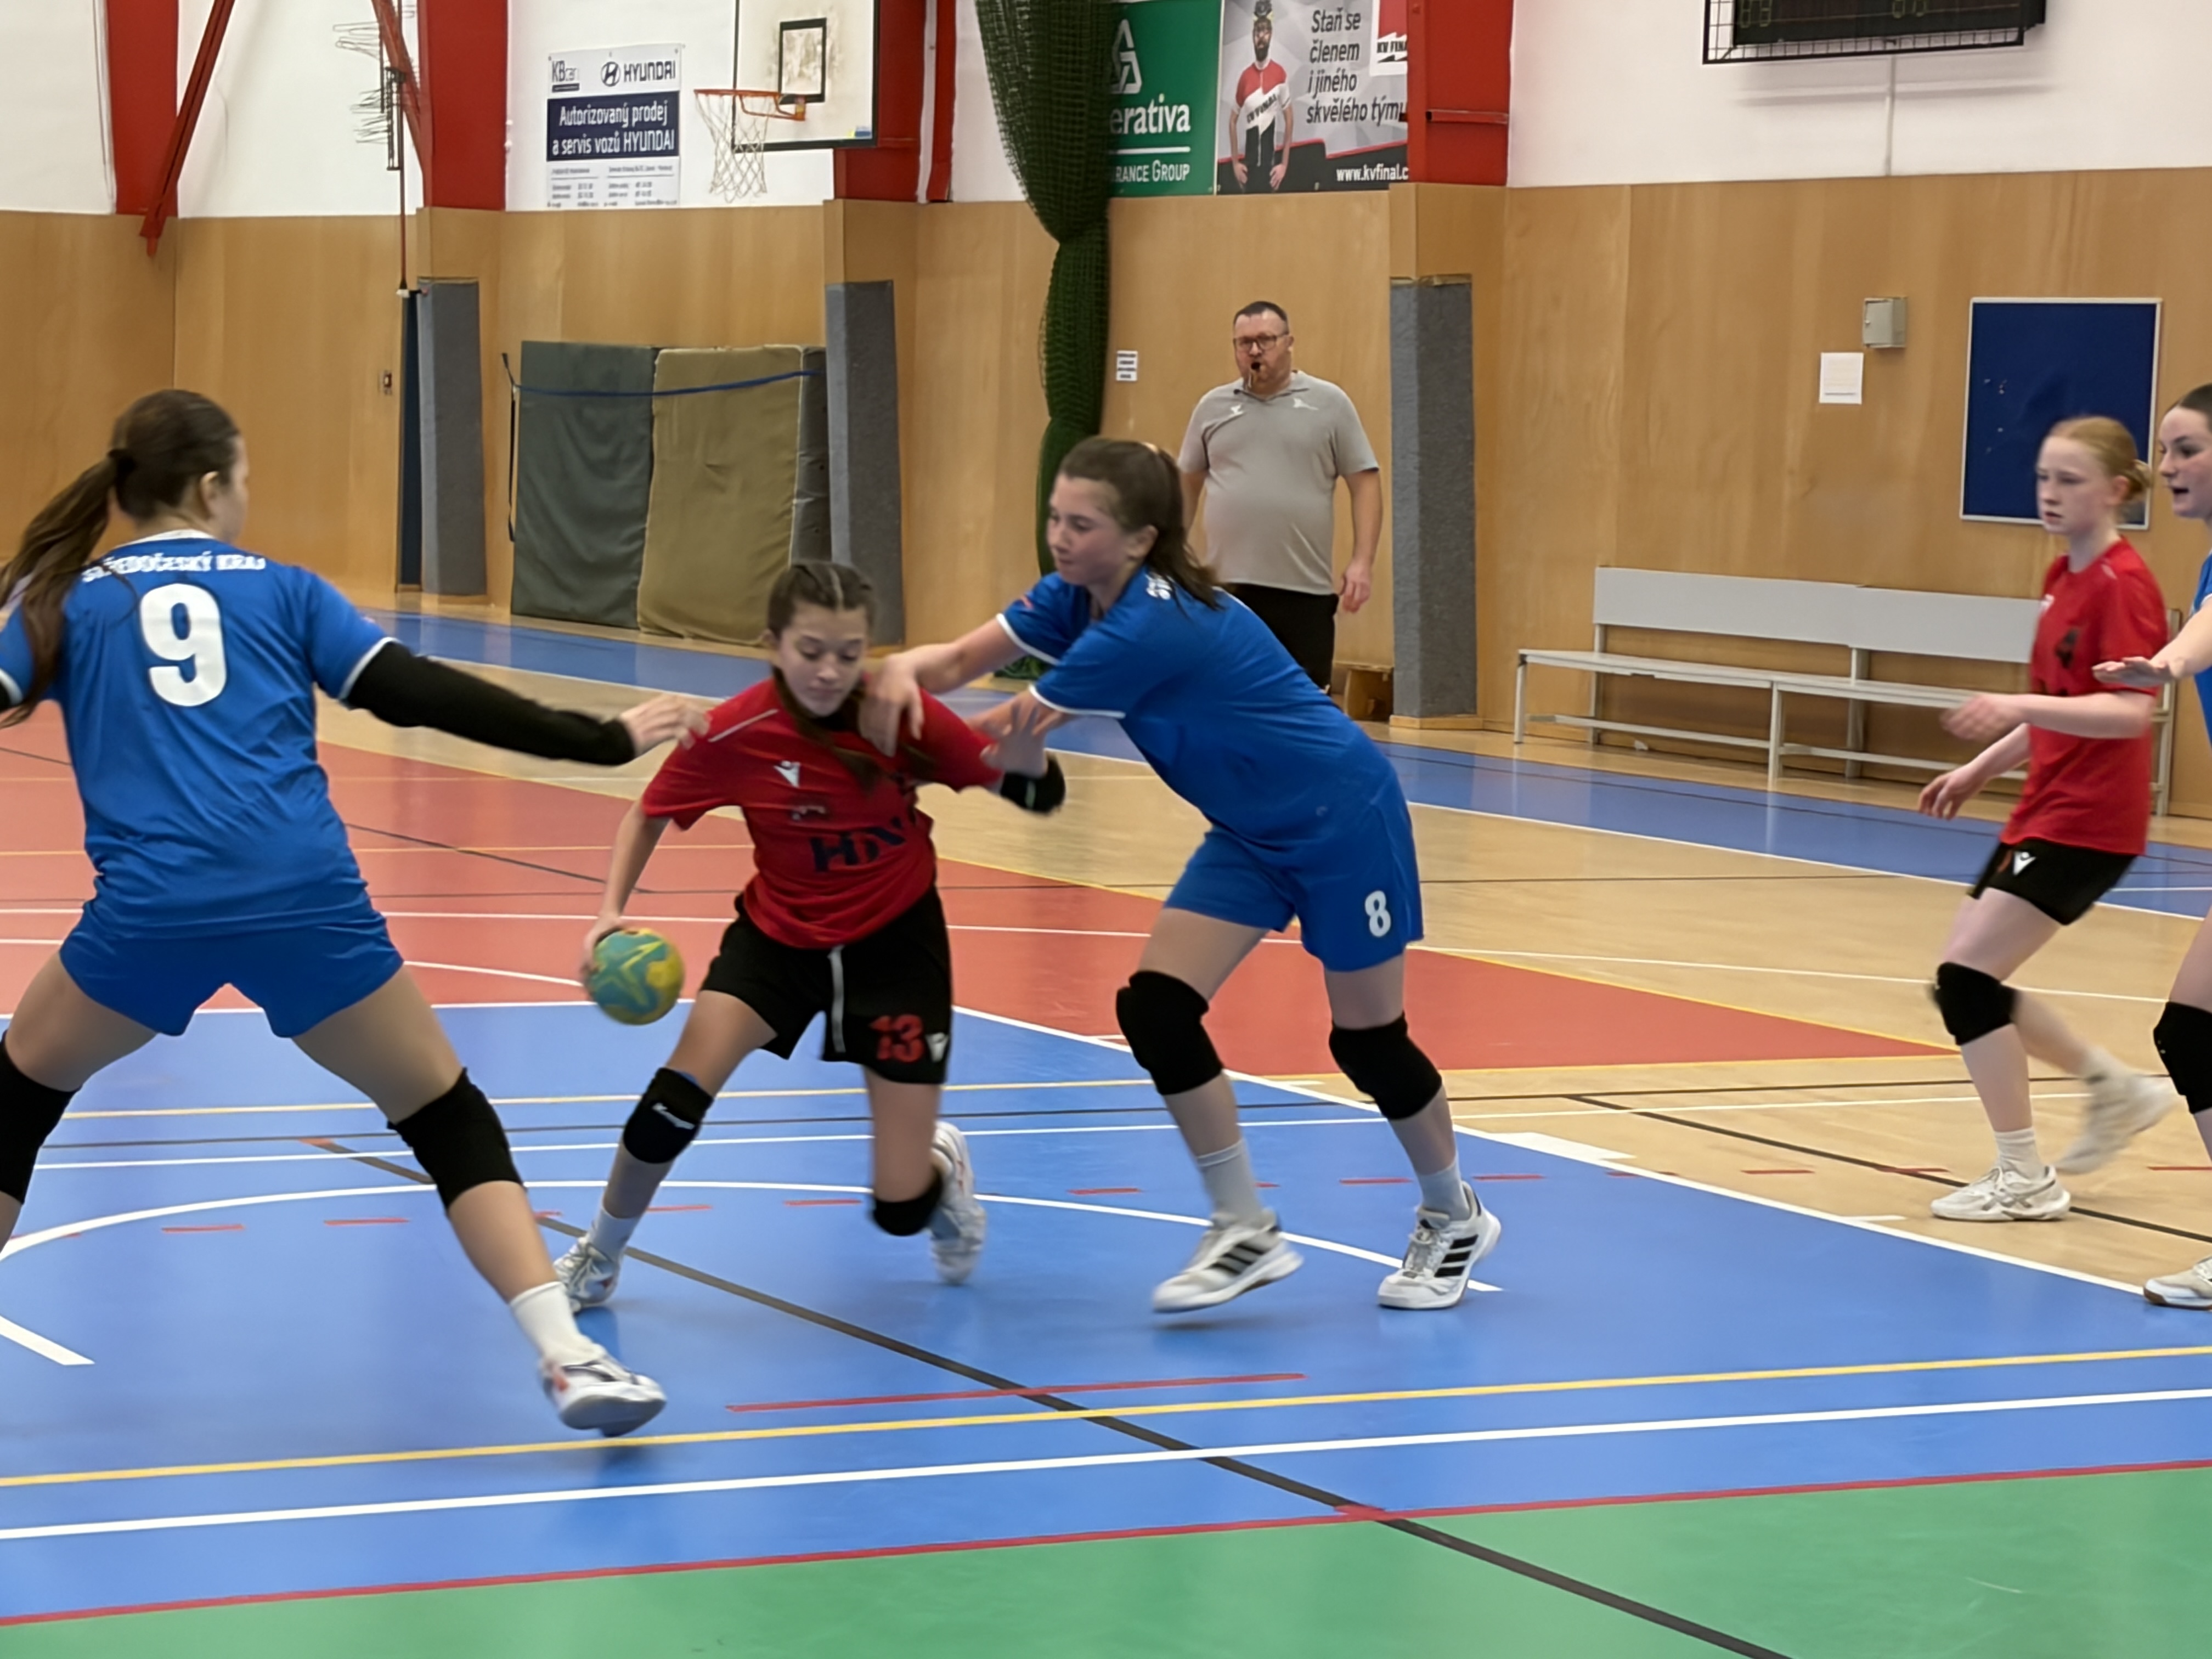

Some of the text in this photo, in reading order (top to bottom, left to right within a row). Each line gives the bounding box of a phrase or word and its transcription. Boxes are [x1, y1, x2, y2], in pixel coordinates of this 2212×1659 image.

[1312, 7, 1361, 33] Staň se
[1310, 39, 1360, 63] členem
[624, 60, 676, 82] HYUNDAI
[1308, 67, 1357, 99] i jiného
[559, 100, 668, 128] Autorizovaný prodej
[1306, 95, 1404, 127] skvělého tým
[552, 139, 559, 156] a
[561, 133, 592, 155] servis
[623, 129, 675, 153] HYUNDAI
[139, 583, 227, 707] 9
[1364, 890, 1391, 938] 8
[868, 1014, 923, 1063] 13
